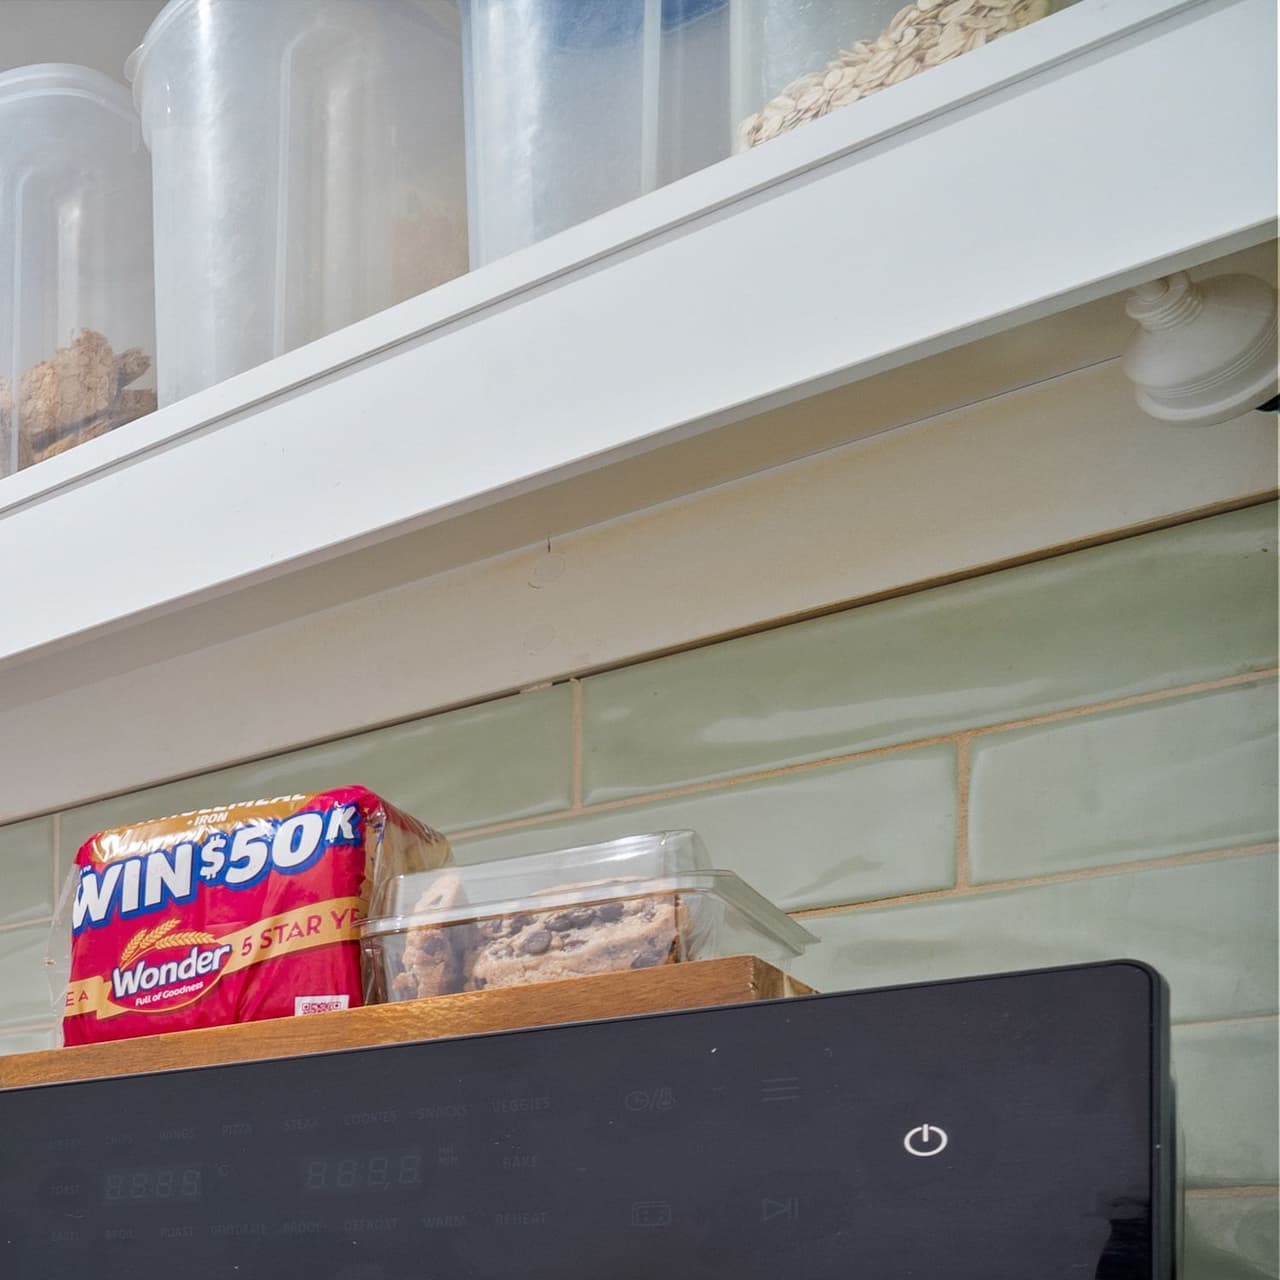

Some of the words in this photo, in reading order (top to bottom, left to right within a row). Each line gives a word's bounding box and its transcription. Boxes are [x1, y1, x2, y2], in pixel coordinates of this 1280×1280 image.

[194, 811, 228, 826] IRON
[73, 844, 192, 929] WIN
[241, 936, 252, 956] 5
[260, 915, 322, 951] STAR
[112, 944, 231, 998] Wonder
[135, 995, 151, 1006] Full
[152, 993, 161, 1003] of
[162, 981, 203, 999] Goodness
